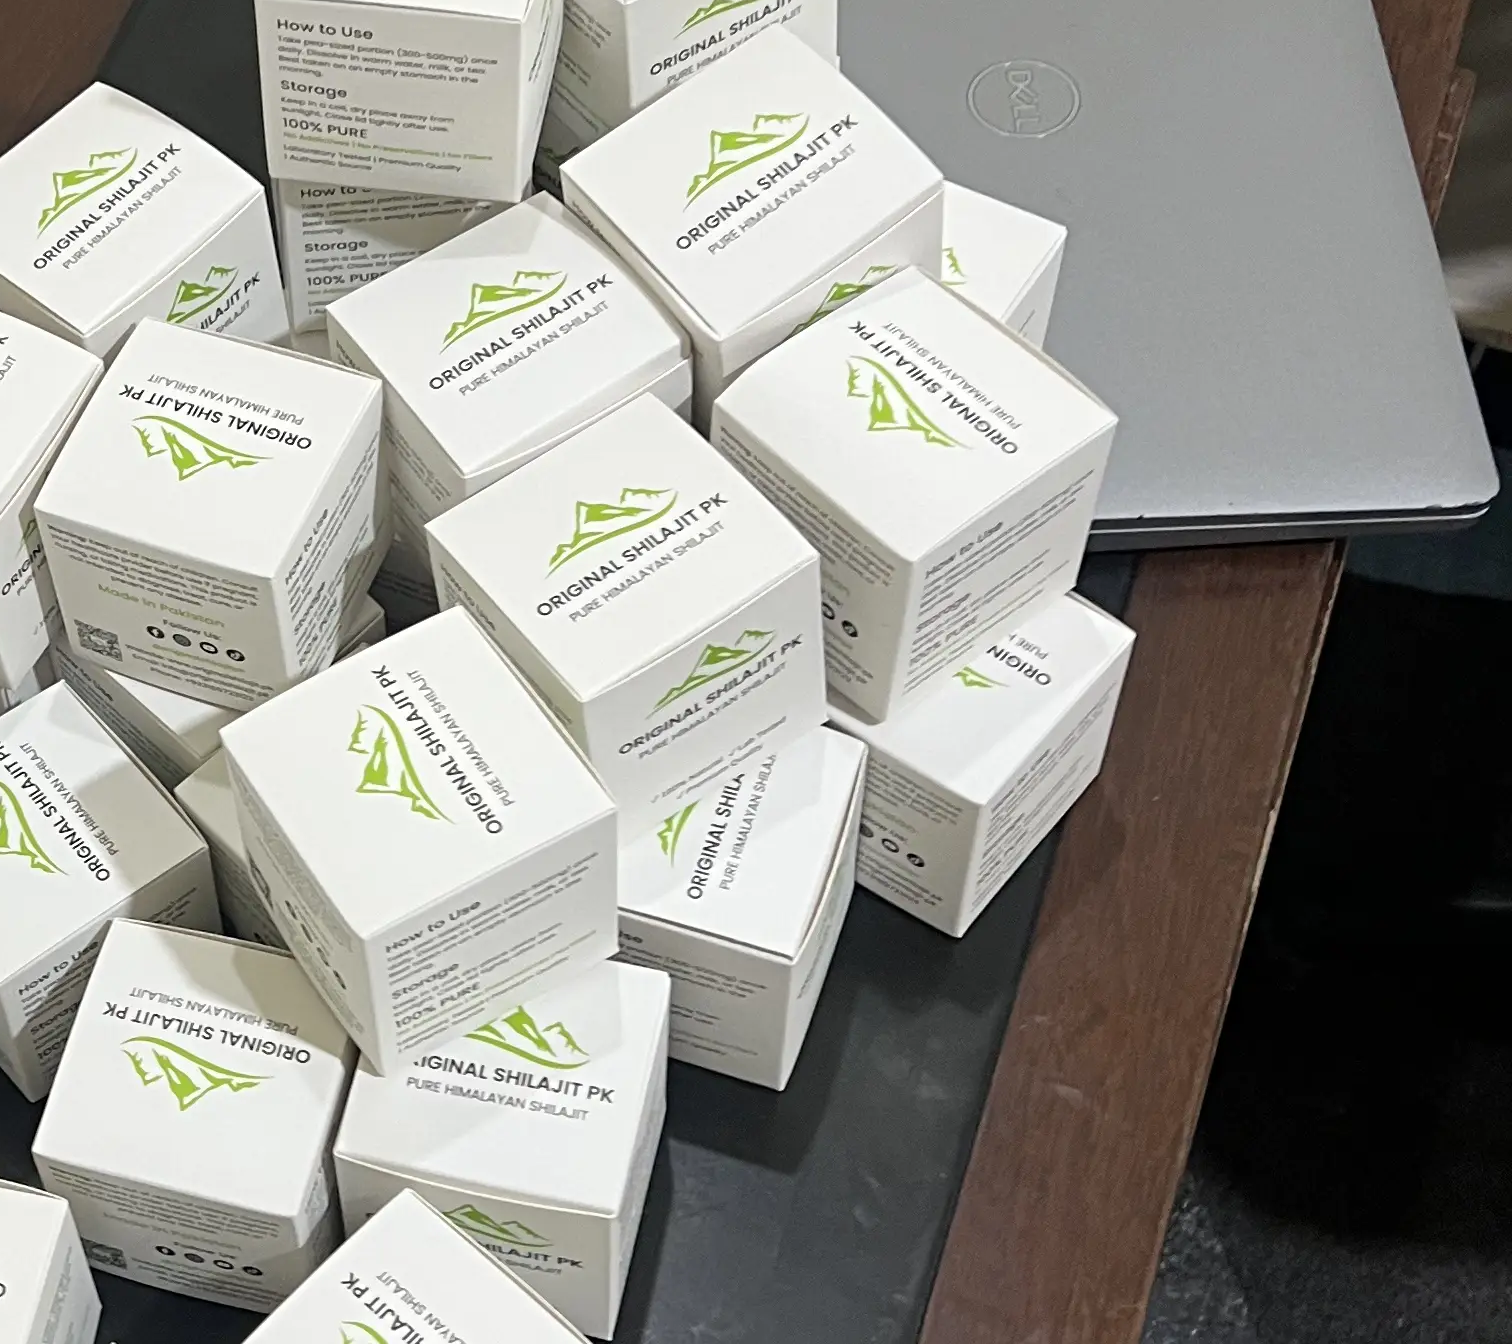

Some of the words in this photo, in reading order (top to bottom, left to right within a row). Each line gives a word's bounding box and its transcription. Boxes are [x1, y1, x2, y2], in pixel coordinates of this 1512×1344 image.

[277, 19, 314, 34] How
[319, 24, 336, 37] to
[342, 26, 373, 40] Use
[650, 30, 725, 75] ORIGINAL
[281, 80, 347, 99] Storage
[1007, 70, 1039, 133] DELL
[283, 117, 323, 133] 100%
[327, 124, 368, 139] PURE
[300, 187, 335, 198] How
[340, 186, 357, 195] to
[676, 189, 759, 249] ORIGINAL
[756, 132, 829, 189] SHILAJIT
[830, 114, 857, 136] PK
[33, 213, 101, 268] ORIGINAL
[98, 160, 157, 212] SHILAJIT
[157, 143, 180, 161] PK
[62, 246, 89, 268] PURE
[87, 199, 143, 247] HIMALAYAN
[141, 166, 181, 200] SHILAJIT
[304, 240, 369, 252] Storage
[244, 272, 260, 292] PK
[307, 275, 346, 286] 100%
[429, 337, 512, 389] ORIGINAL
[511, 289, 584, 338] SHILAJIT
[586, 274, 612, 293] PK
[848, 321, 875, 340] PK
[147, 374, 197, 393] SHILAJIT
[870, 340, 941, 392] SHILAJIT
[119, 385, 144, 399] PK
[145, 393, 222, 422] SHILAJIT
[198, 388, 270, 415] HIMALAYAN
[228, 415, 311, 448] ORIGINAL
[272, 409, 303, 425] PURE
[941, 391, 1017, 453] ORIGINAL
[1, 544, 42, 596] ORIGIN
[537, 560, 623, 615] ORIGINAL
[621, 509, 698, 561] SHILAJIT
[699, 493, 727, 513] PK
[98, 584, 139, 603] Made
[143, 598, 157, 609] in
[160, 603, 225, 628] Pakistan
[371, 665, 396, 687] PK
[986, 645, 1050, 685] ORIGIN
[406, 670, 445, 712] SHILAJIT
[618, 703, 702, 754] ORIGINAL
[706, 651, 776, 703] SHILAJIT
[780, 634, 801, 654] PK
[388, 690, 445, 755] SHILAJIT
[439, 713, 492, 776] HIMALAYAN
[4, 761, 56, 817] SHILAJIT
[440, 756, 502, 833] ORIGINAL
[487, 777, 515, 805] PURE
[53, 815, 109, 880] ORIGINAL
[687, 823, 727, 898] ORIGINAL
[715, 773, 744, 817] SHILA
[18, 972, 50, 995] How
[54, 961, 69, 973] to
[71, 941, 99, 962] Use
[392, 963, 459, 999] Storage
[102, 1001, 128, 1019] PK
[130, 1010, 214, 1039] SHILAJIT
[220, 1029, 310, 1063] ORIGINAL
[413, 1055, 487, 1079] IGINAL
[493, 1067, 582, 1096] SHILAJIT
[587, 1085, 614, 1102] PK
[340, 1272, 368, 1298] PK
